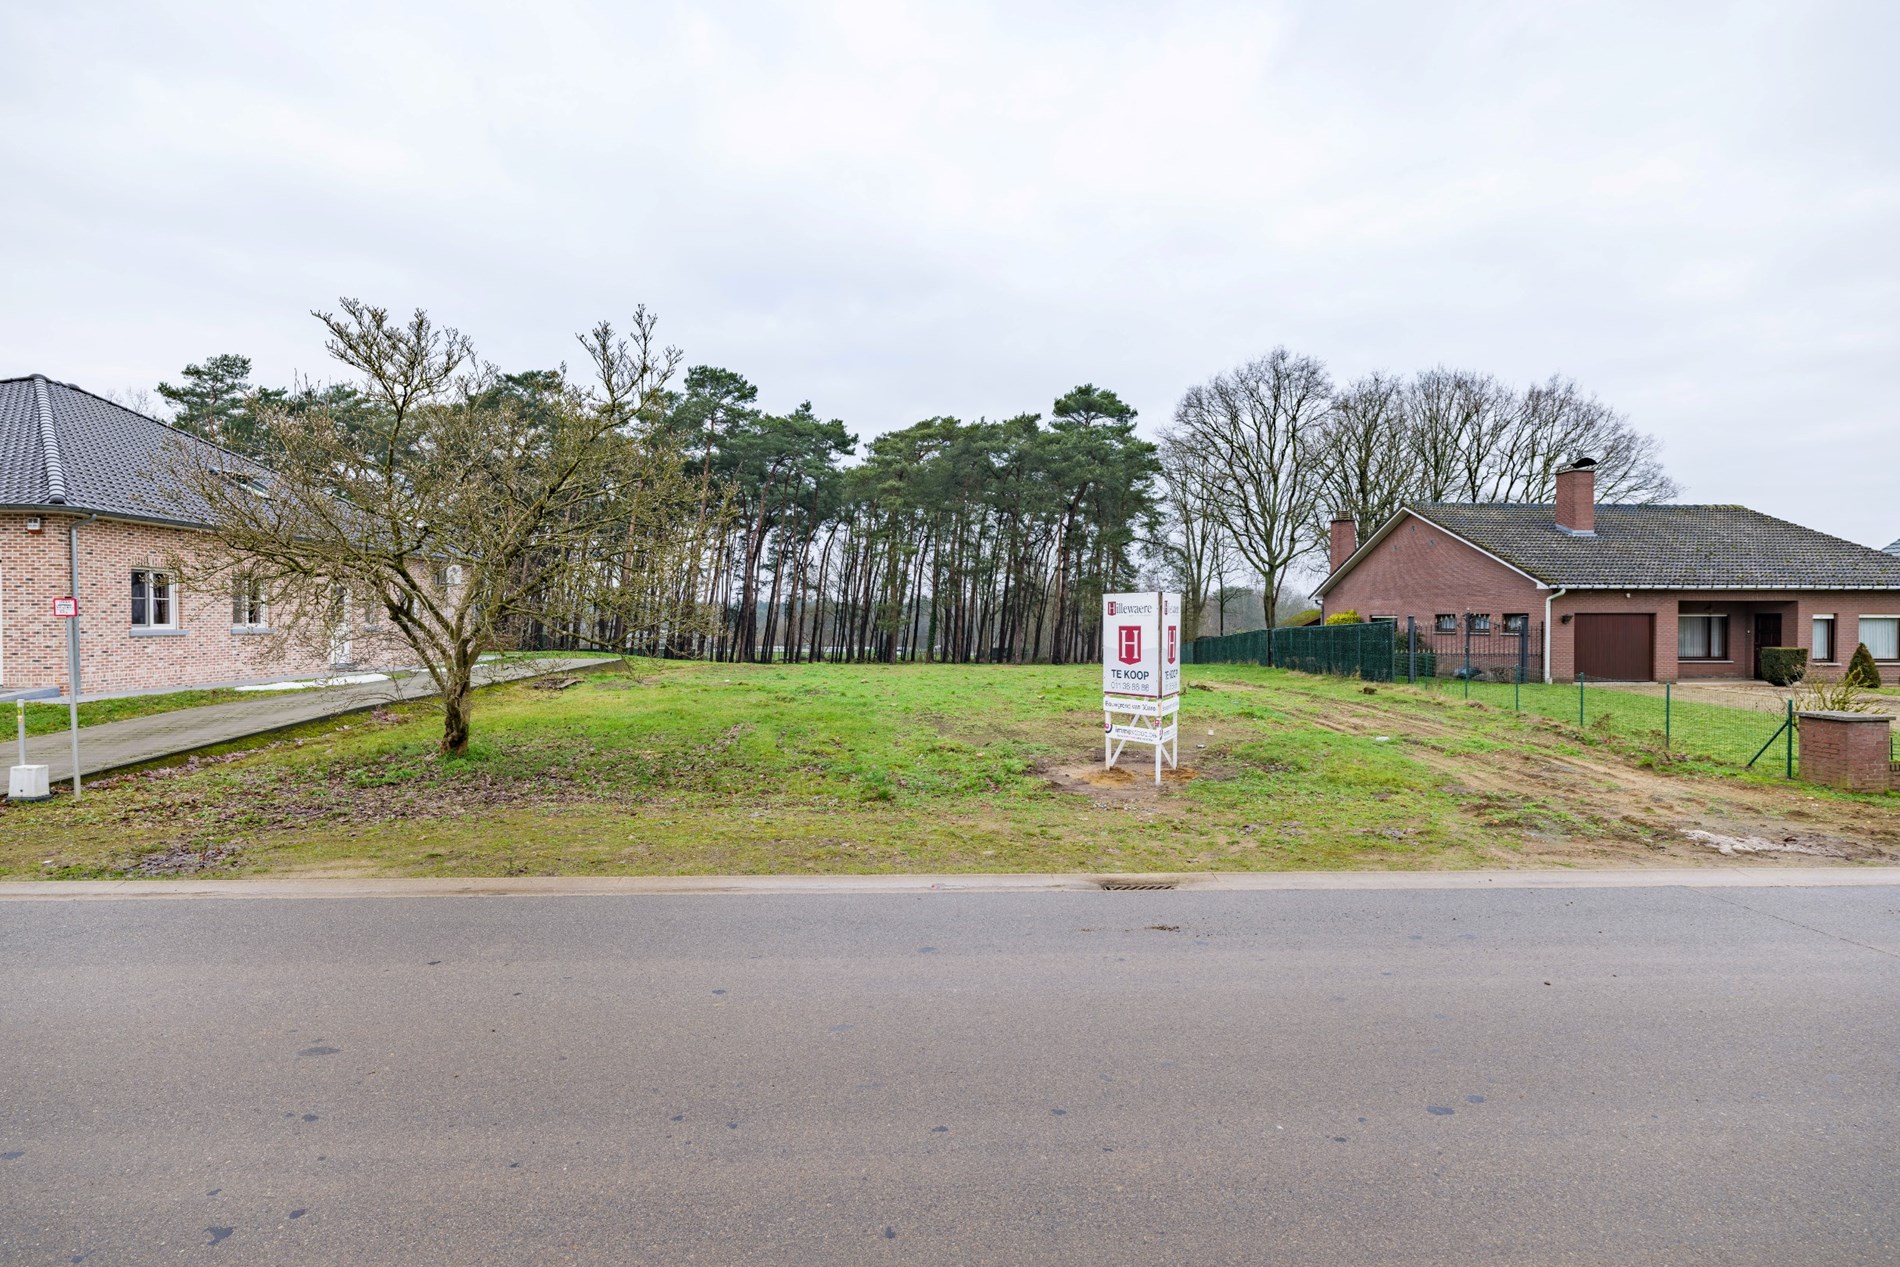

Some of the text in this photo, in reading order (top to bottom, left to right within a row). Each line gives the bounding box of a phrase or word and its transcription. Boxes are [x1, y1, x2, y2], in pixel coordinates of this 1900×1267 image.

[1108, 602, 1152, 616] Hillewaere
[1120, 629, 1140, 659] H
[1168, 629, 1176, 659] H
[1111, 669, 1150, 680] TE KOOP
